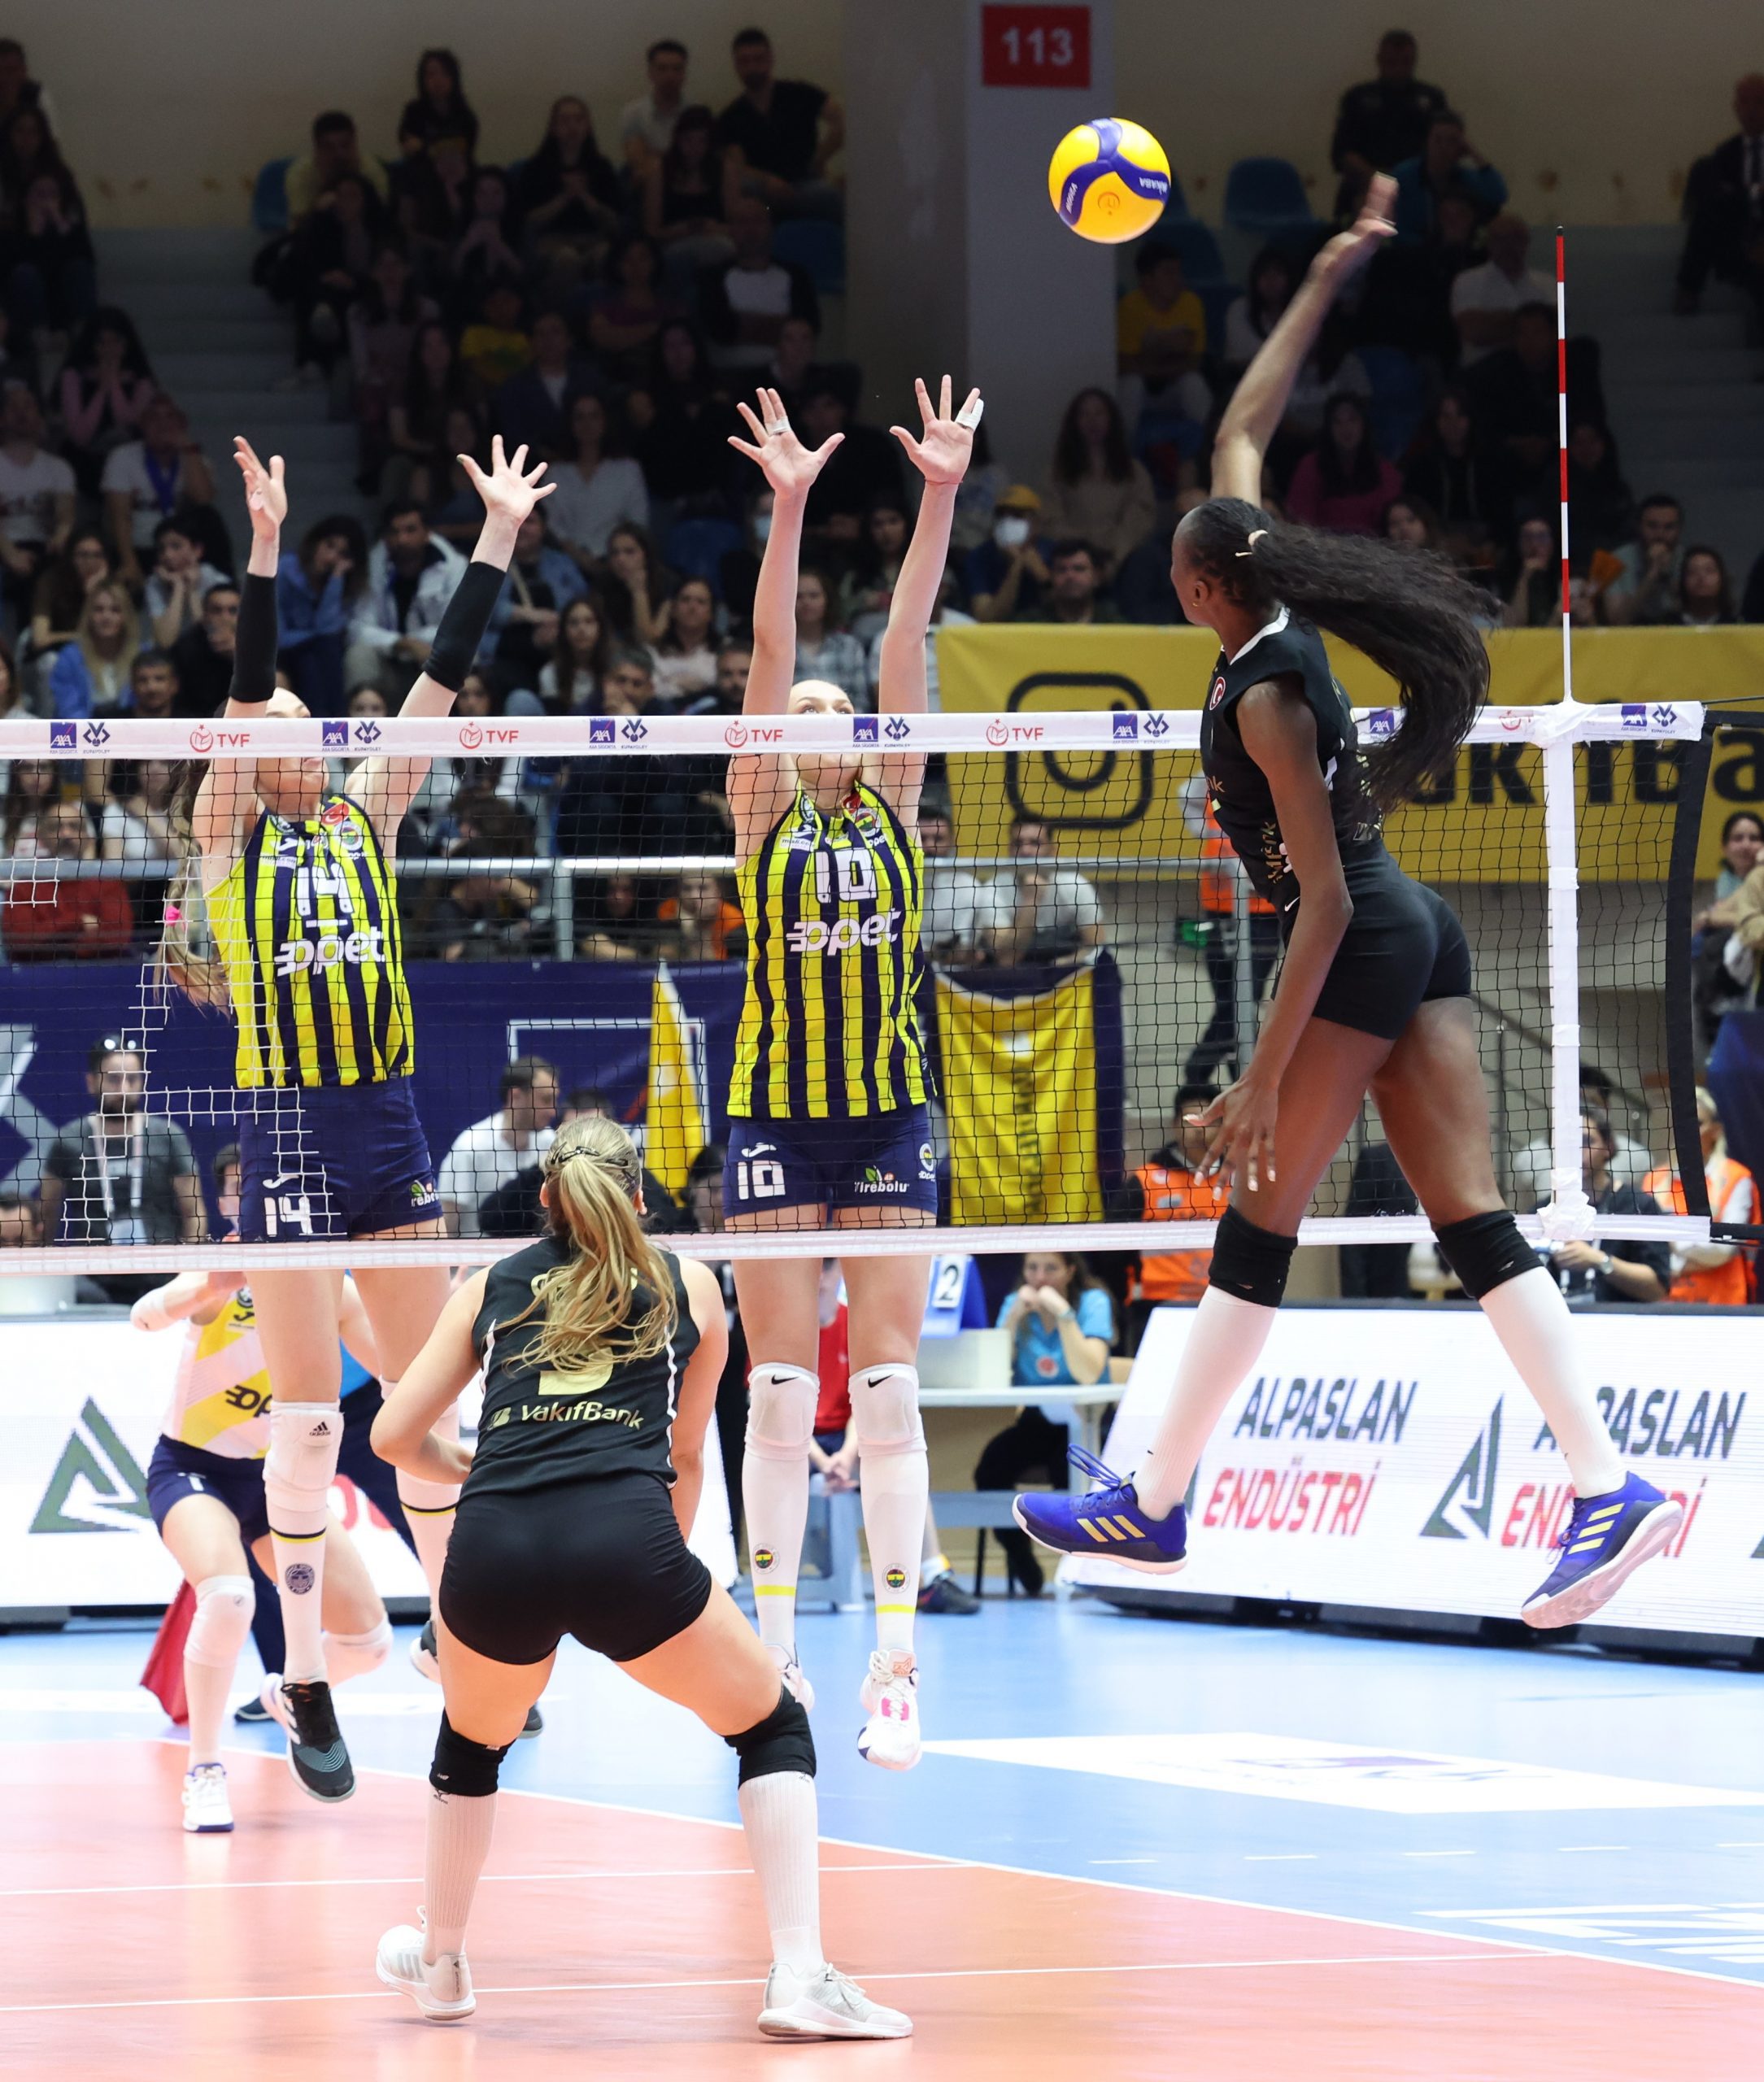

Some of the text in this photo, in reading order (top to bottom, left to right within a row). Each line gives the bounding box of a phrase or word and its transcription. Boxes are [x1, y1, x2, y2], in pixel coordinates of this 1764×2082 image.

[1001, 25, 1074, 66] 113
[323, 732, 344, 743] AXA
[486, 730, 520, 743] TVF
[590, 730, 611, 742] AXA
[751, 729, 783, 743] TVF
[853, 728, 874, 740] AXA
[1012, 727, 1044, 741] TVF
[1113, 725, 1134, 738] AXA
[1370, 721, 1390, 732] AXA
[50, 734, 72, 747] AXA
[216, 733, 250, 747] TVF
[815, 847, 878, 903] 10
[296, 862, 355, 917] 14
[786, 908, 901, 956] opet
[274, 926, 385, 977] opet
[738, 1159, 786, 1200] 10
[264, 1196, 313, 1237] 14
[938, 1264, 960, 1301] 2
[1233, 1376, 1418, 1444] ALPASLAN
[1202, 1453, 1382, 1535] ENDÜSTRİ
